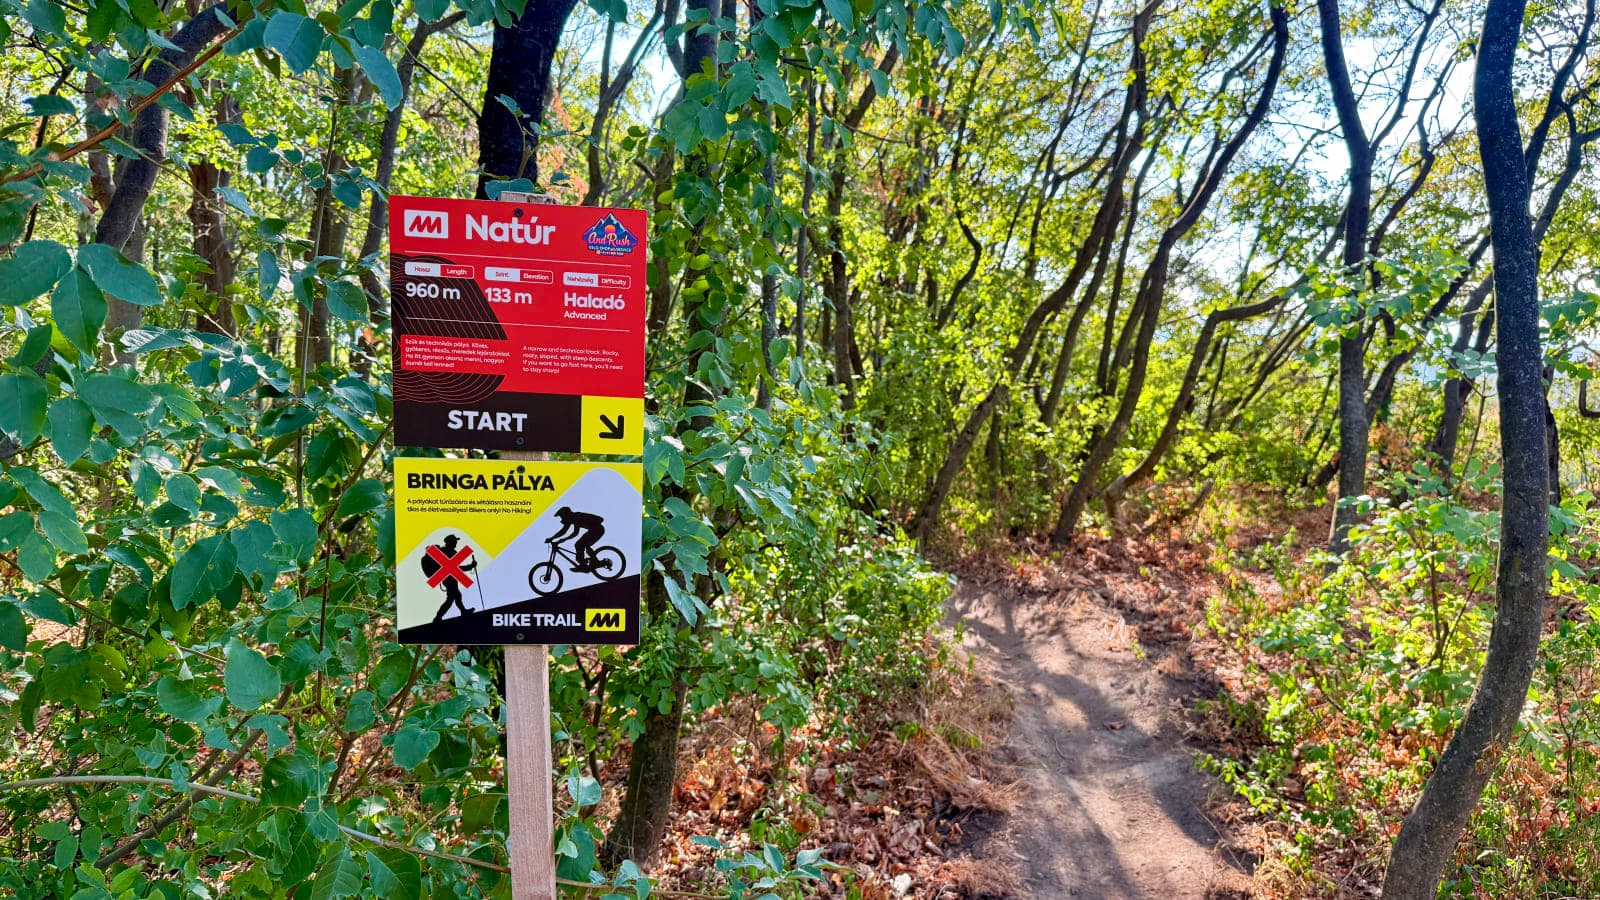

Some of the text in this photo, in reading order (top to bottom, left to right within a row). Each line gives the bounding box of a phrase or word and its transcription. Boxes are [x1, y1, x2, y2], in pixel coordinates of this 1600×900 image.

[465, 213, 556, 245] Natúr
[607, 232, 630, 247] Rush
[446, 267, 467, 275] Length
[567, 276, 627, 286] Nehézség Difficulty
[405, 282, 461, 300] 960 m
[485, 287, 532, 304] 133 m
[564, 292, 625, 310] Haladó
[564, 310, 607, 321] Advanced
[447, 410, 528, 433] START
[407, 470, 555, 491] BRINGA PÁLYA
[492, 613, 582, 627] BIKE TRAIL
